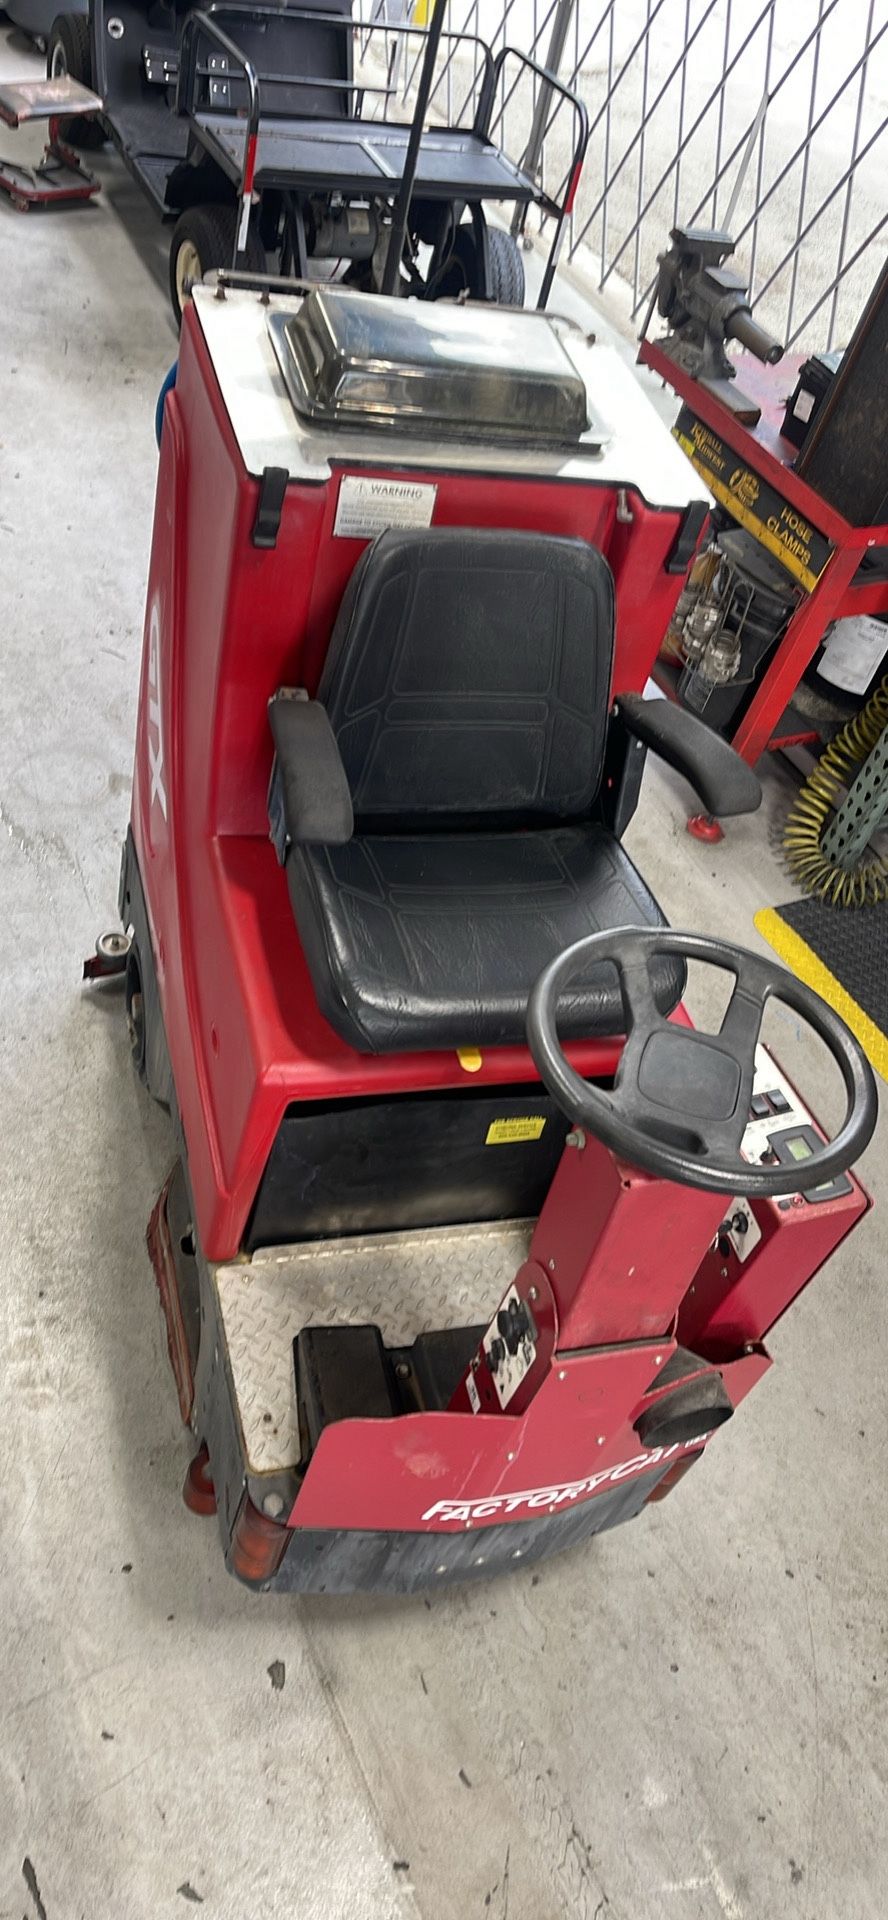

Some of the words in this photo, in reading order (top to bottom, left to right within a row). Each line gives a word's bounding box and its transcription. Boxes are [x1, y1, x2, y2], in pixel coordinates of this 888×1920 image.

[371, 484, 423, 499] WARNING
[767, 515, 811, 566] CLAMPS
[780, 506, 813, 545] HOSE
